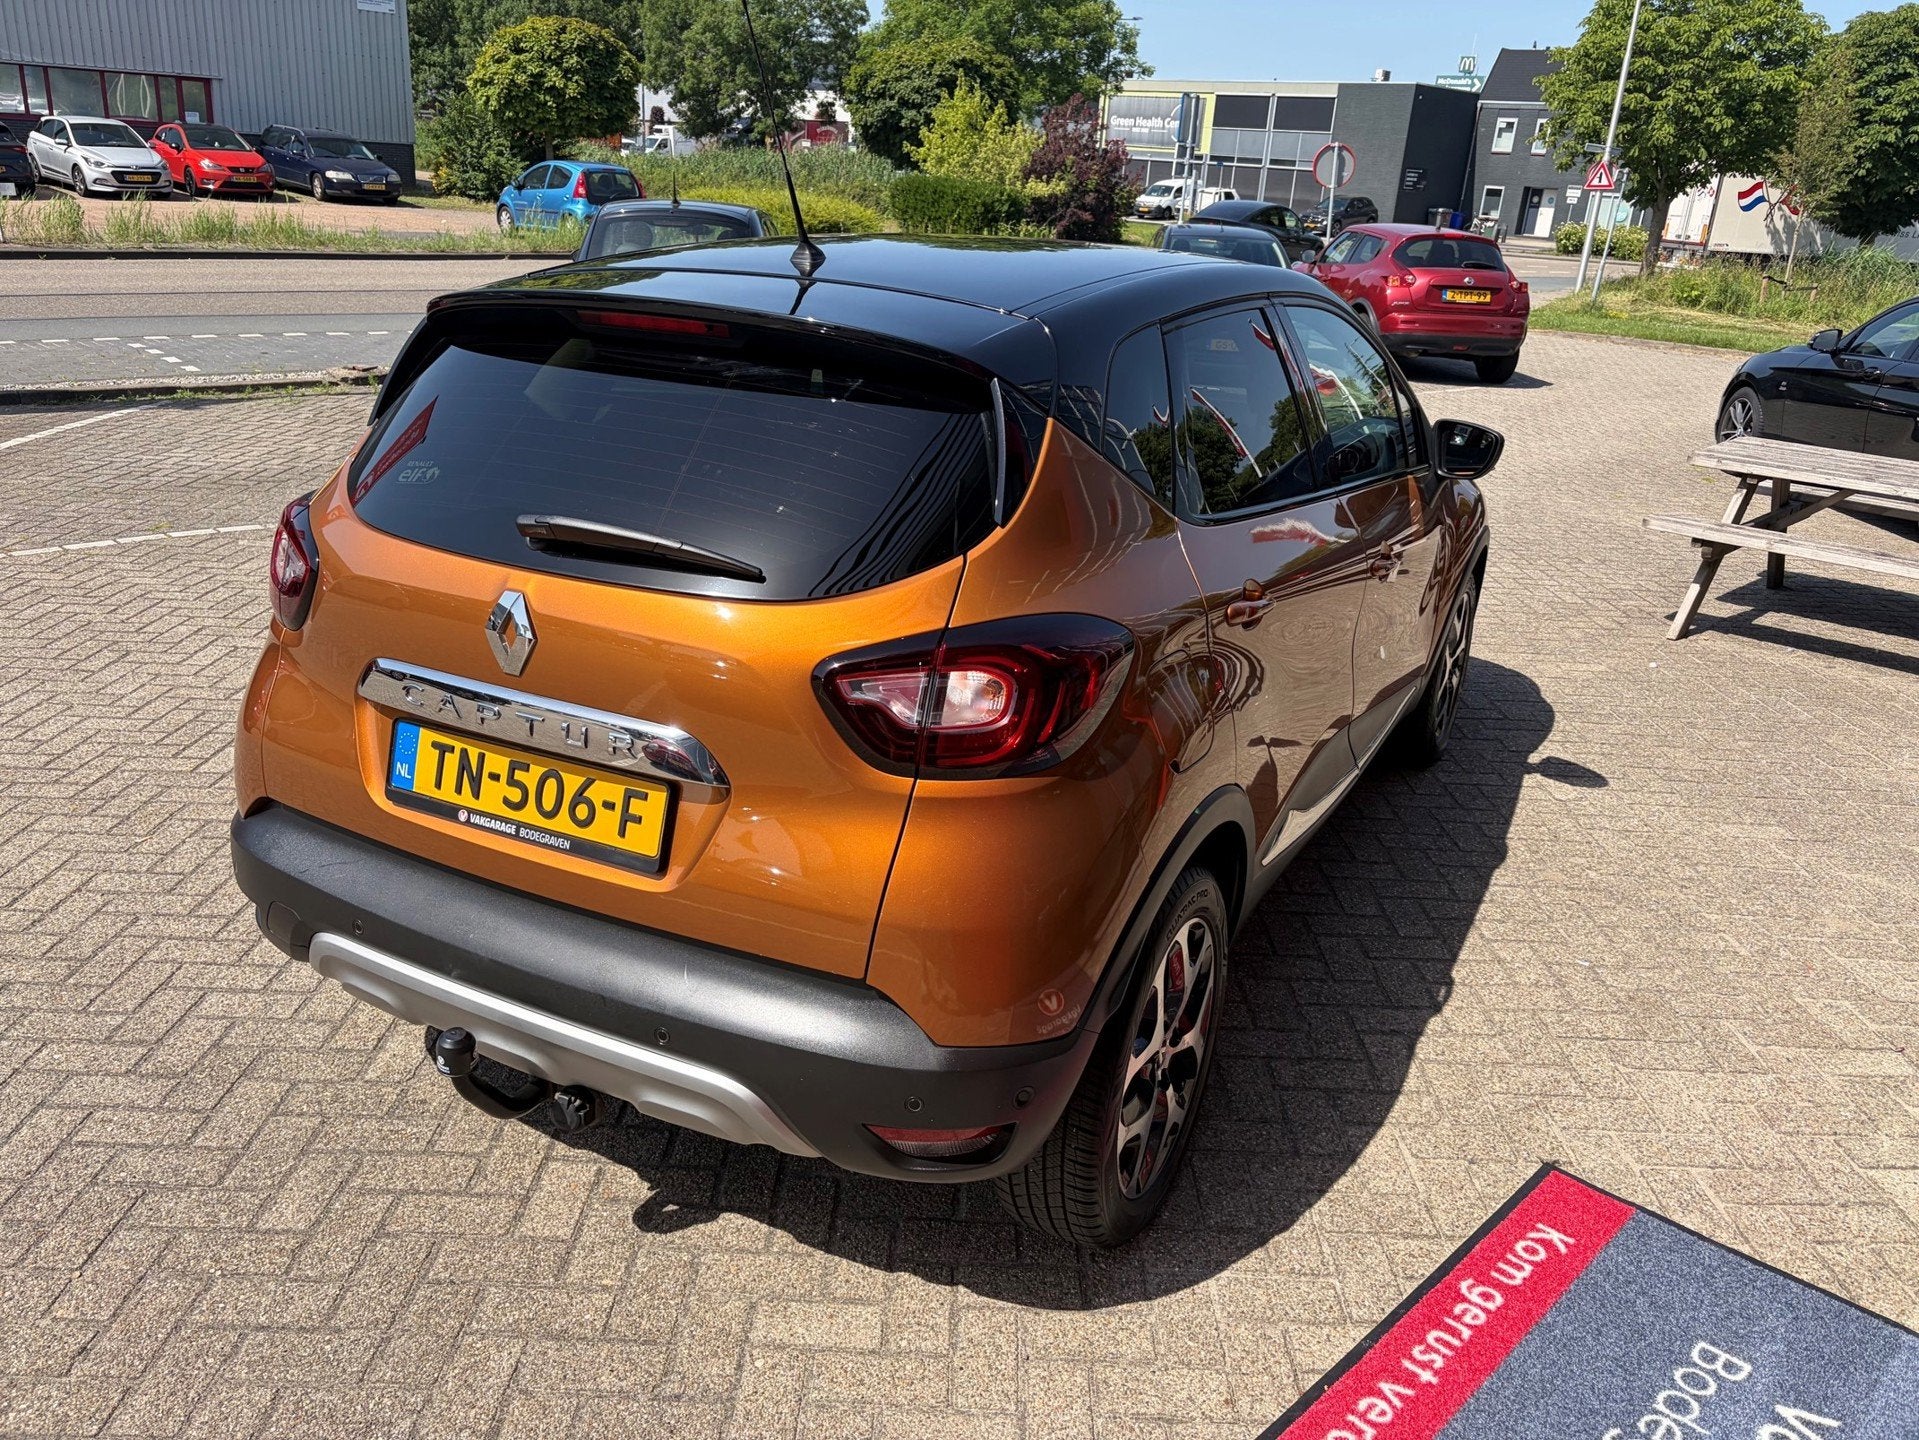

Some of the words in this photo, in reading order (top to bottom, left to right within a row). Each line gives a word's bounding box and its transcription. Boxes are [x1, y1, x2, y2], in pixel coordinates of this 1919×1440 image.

[1110, 115, 1135, 126] Green
[1136, 116, 1164, 128] Health
[398, 467, 425, 482] elf
[402, 682, 638, 759] CAPTUR
[396, 761, 411, 779] NL
[431, 740, 649, 838] TN-506-F
[469, 813, 517, 835] VAKGARAGE
[519, 827, 571, 850] BODEGRAVEN
[1490, 1222, 1576, 1287] Kom
[1400, 1277, 1505, 1386] gerust
[1602, 1341, 1752, 1440] Bode
